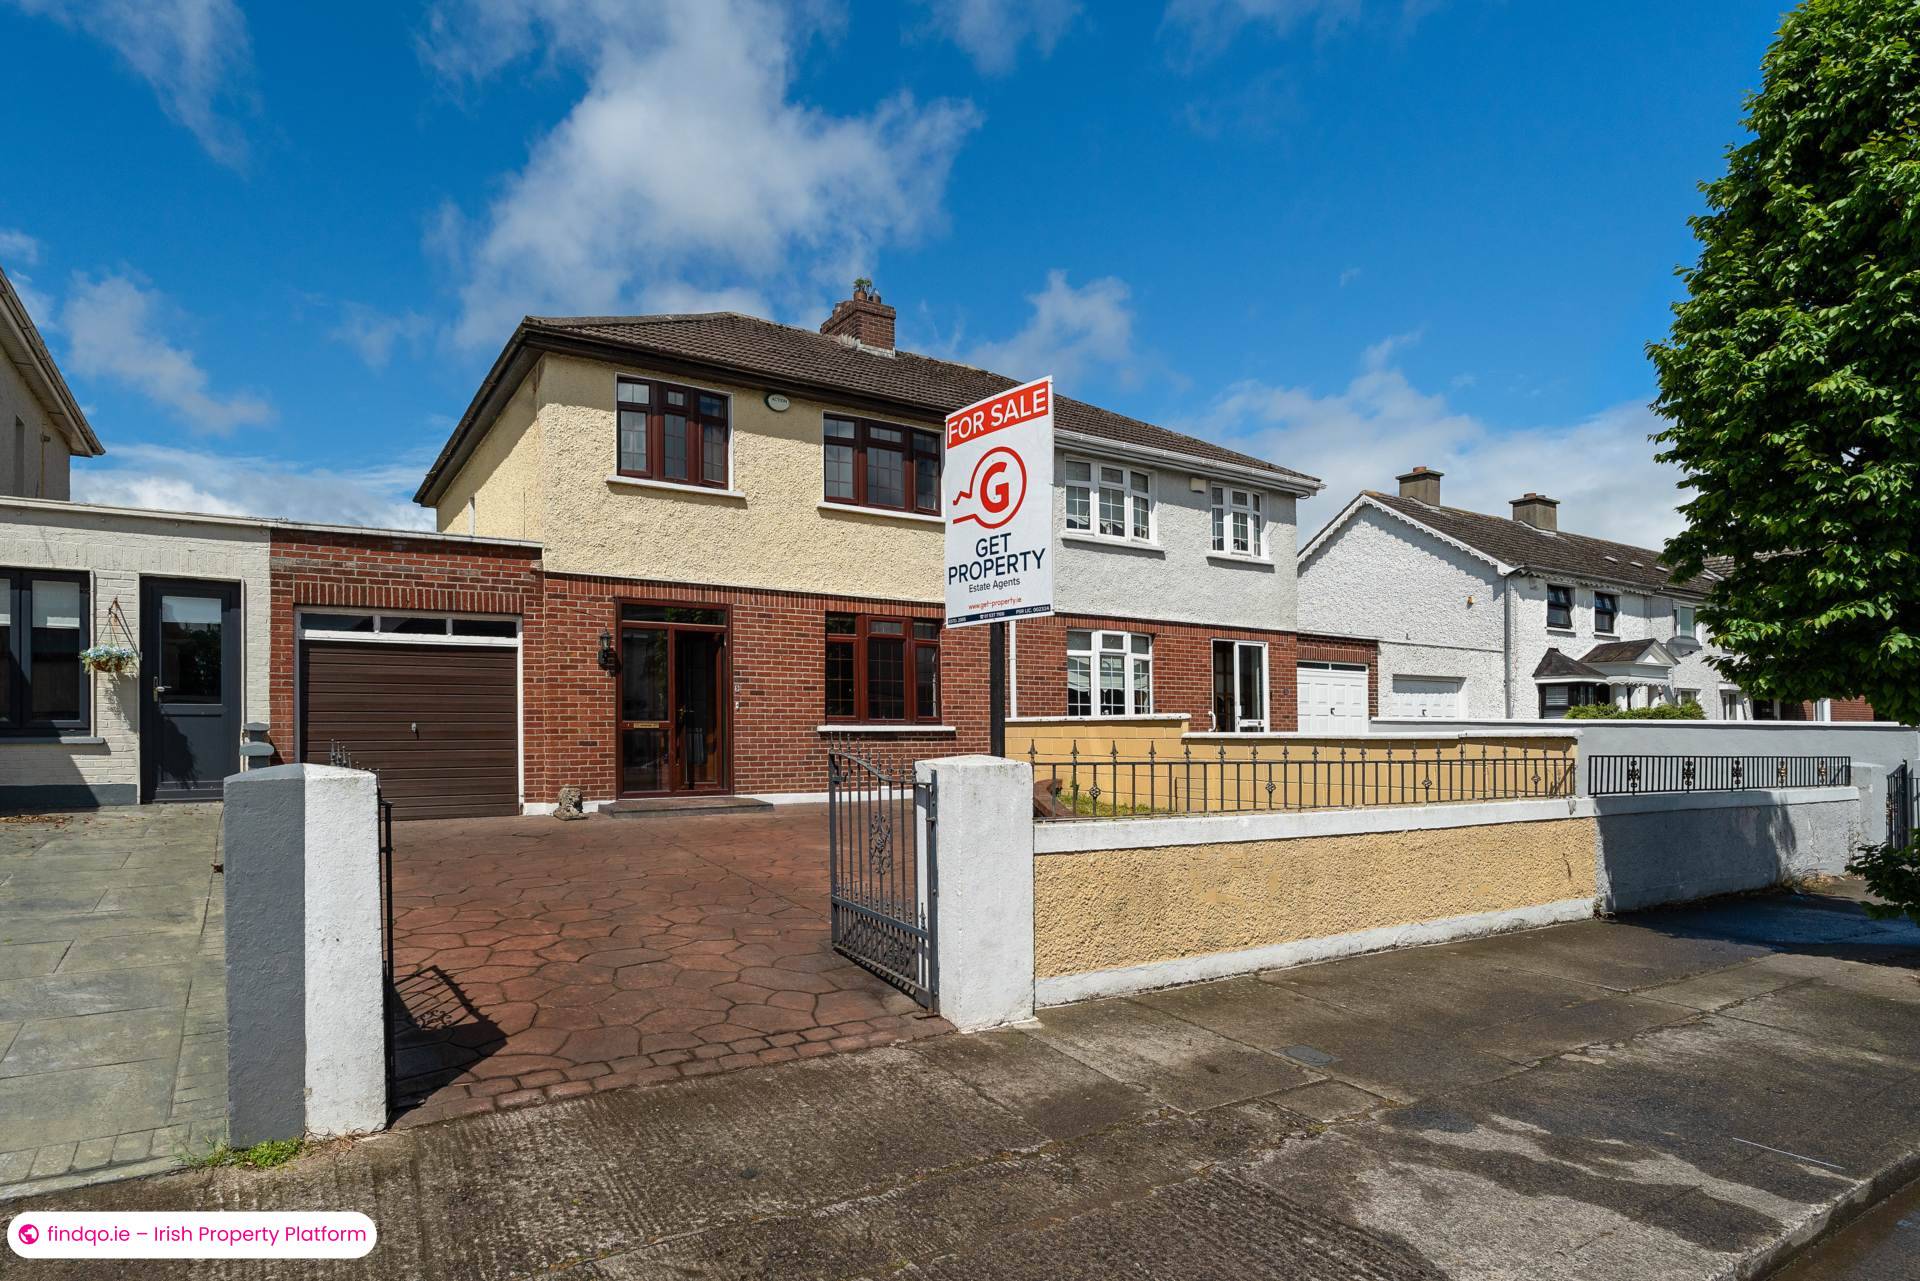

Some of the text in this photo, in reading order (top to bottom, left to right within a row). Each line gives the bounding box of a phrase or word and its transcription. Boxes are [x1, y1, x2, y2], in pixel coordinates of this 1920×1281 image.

[948, 388, 1046, 444] FOR SALE
[980, 461, 1009, 513] G
[976, 532, 1012, 558] GET
[948, 548, 1046, 585] PROPERTY
[968, 577, 1021, 593] Estate Agents
[968, 596, 1022, 610] www.get-property.ie
